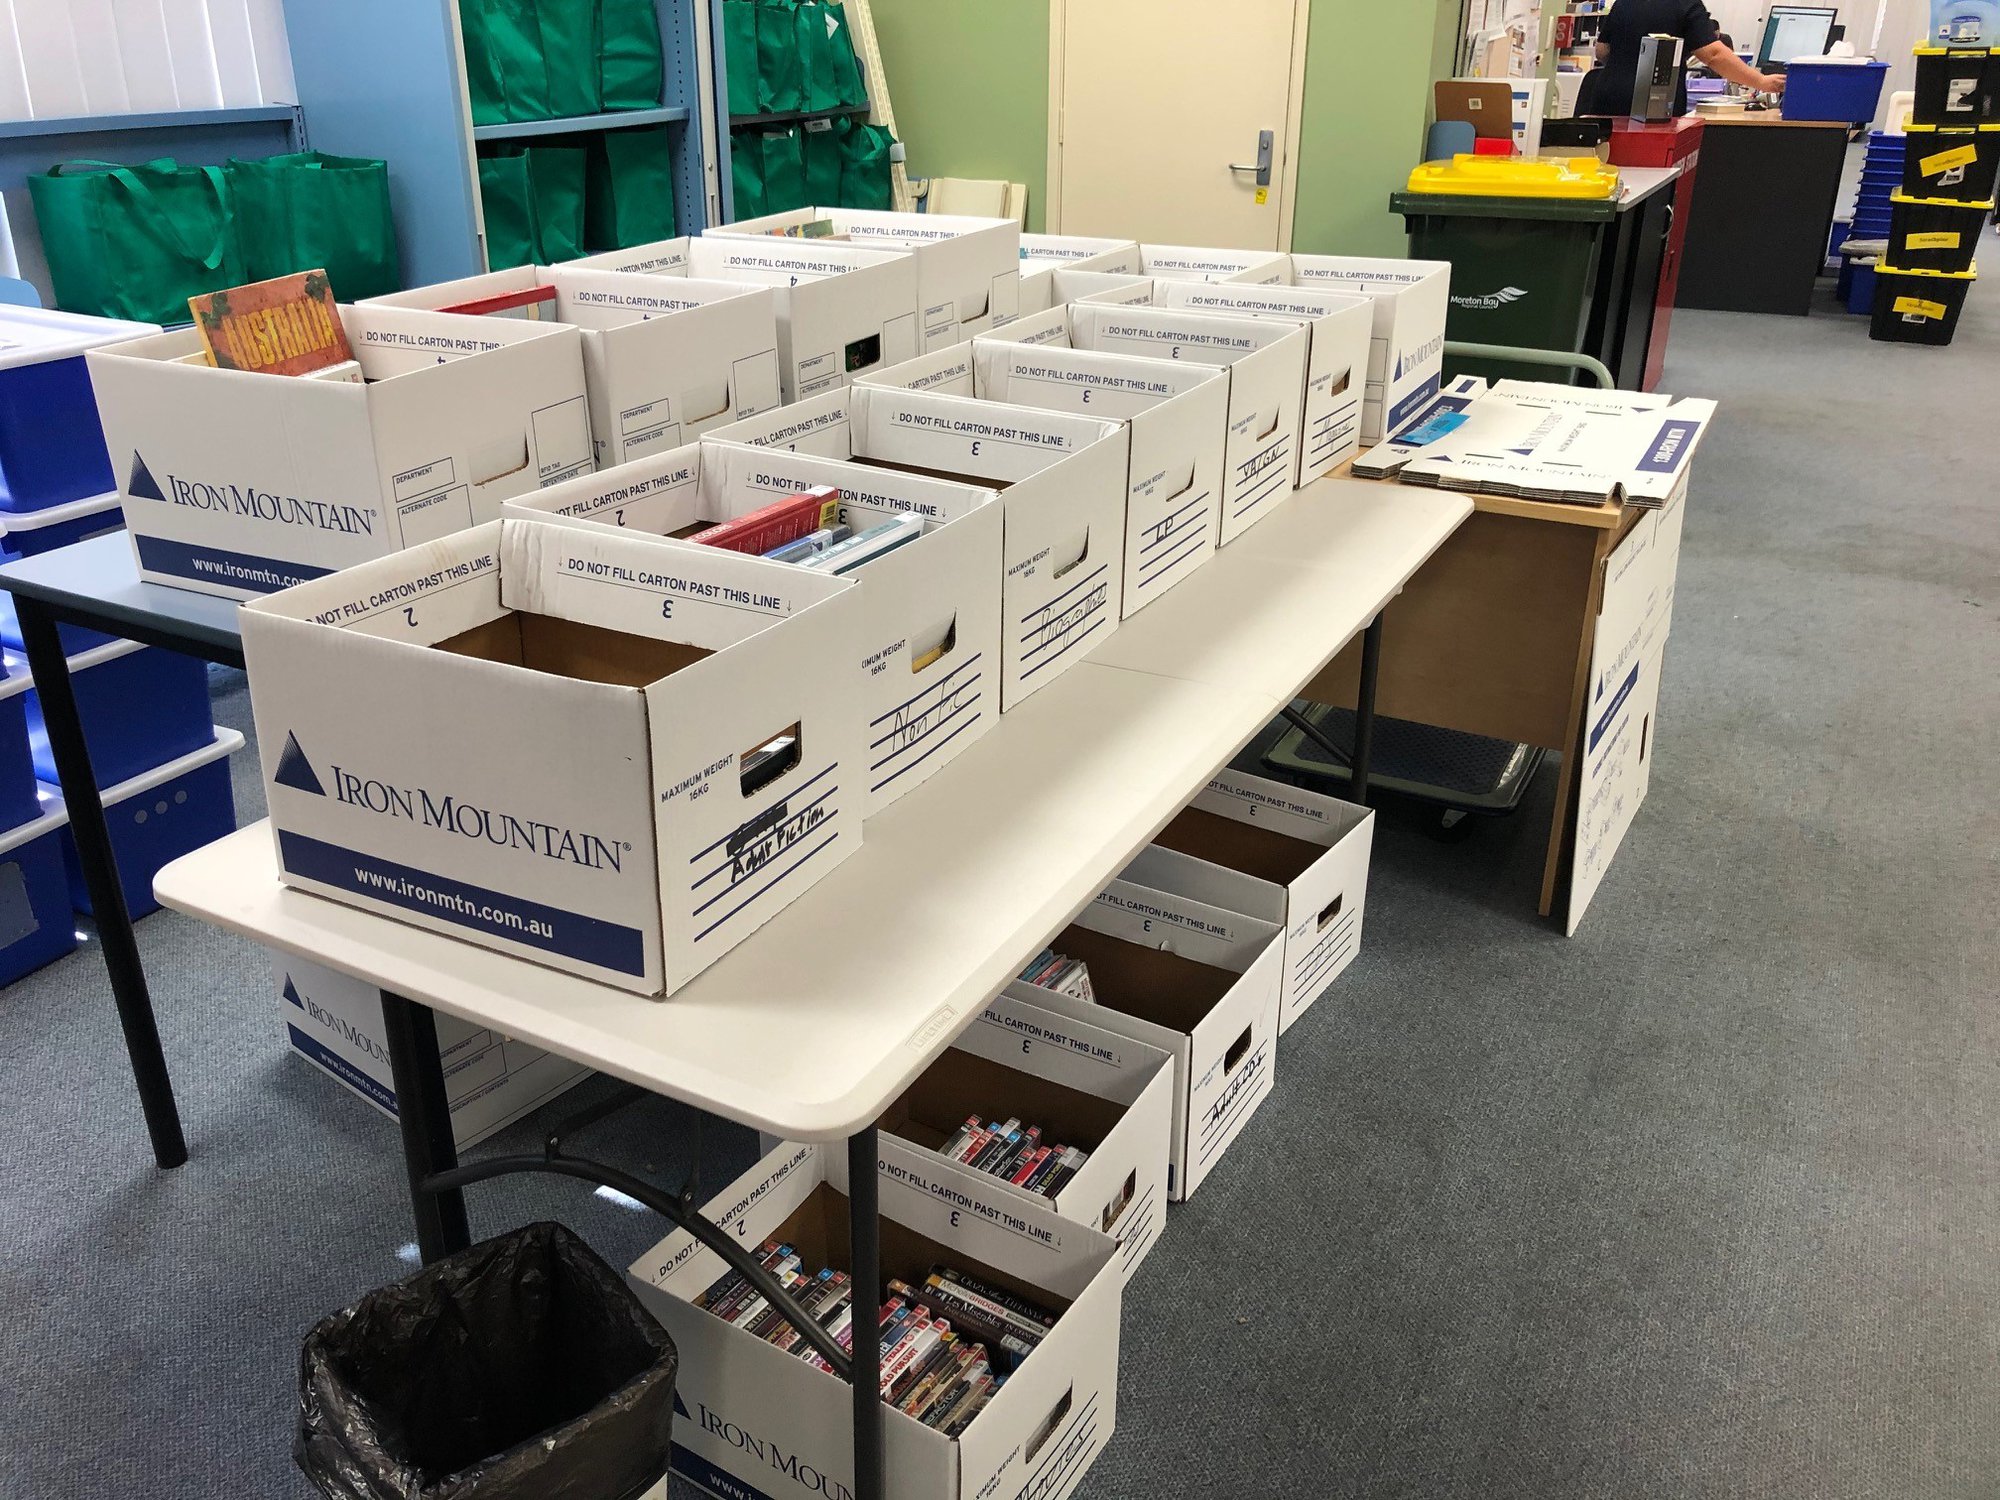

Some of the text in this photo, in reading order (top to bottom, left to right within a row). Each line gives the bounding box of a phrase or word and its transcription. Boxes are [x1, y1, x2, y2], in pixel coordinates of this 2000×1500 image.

[730, 256, 847, 274] DO NOT FILL CARTON PAST THIS
[579, 292, 680, 310] DO NOT FILL CARTON PAST
[1236, 301, 1324, 315] CARTON PAST THIS LINE
[1482, 297, 1499, 309] Bay
[221, 296, 338, 371] AUSTRALIA
[366, 331, 478, 350] DO NOT FILL CARTON PAST
[1108, 326, 1250, 348] DO NOT FILL CARTON PAST THIS LINE
[1015, 365, 1168, 394] DO NOT FILL CARTON PAST THIS LINE
[770, 410, 843, 443] CARTON PAST THIS LINE
[900, 412, 1064, 446] DO NOT FILL CARTON PAST THIS LINE
[396, 466, 432, 485] DEPARTMENT
[572, 468, 689, 515] FILL CARTON PAST THIS LINE
[167, 475, 230, 512] IRON
[401, 494, 448, 516] ALTERNATE CODE
[756, 474, 770, 486] DO
[772, 478, 792, 490] NOT
[860, 492, 886, 506] PAST
[888, 497, 912, 511] THIS
[914, 502, 938, 516] LINE
[1008, 548, 1050, 577] MAXIMUM WEIGHT
[343, 555, 493, 618] FILL CARTON PAST THIS LINE
[568, 558, 780, 610] DO NOT FILL CARTON PAST THIS LINE
[662, 600, 674, 619] 3
[882, 639, 906, 657] WEIGHT
[870, 662, 886, 676] 16KG
[331, 765, 416, 822] IRON
[661, 754, 734, 802] MAXIMUM WEIGHT
[689, 783, 710, 802] 16KG
[1236, 788, 1322, 818] CARTON PAST THIS LINE
[354, 866, 554, 938] www.ironmtn.com.au
[1108, 895, 1226, 936] FILL CARTON PAST THIS LINE
[305, 996, 342, 1034] IRON
[341, 1018, 392, 1067] MOUN
[984, 1010, 1113, 1060] FILL CARTON PAST THIS LINE
[320, 1051, 399, 1111] www.ironmtn.com.a
[789, 1148, 807, 1168] LINE
[887, 1163, 1053, 1243] NOT FILL CARTON PAST THIS LINE
[659, 1166, 790, 1277] DO NOT CARTON PAST THIS
[698, 1402, 764, 1461] IRON
[770, 1442, 854, 1500] MOUN
